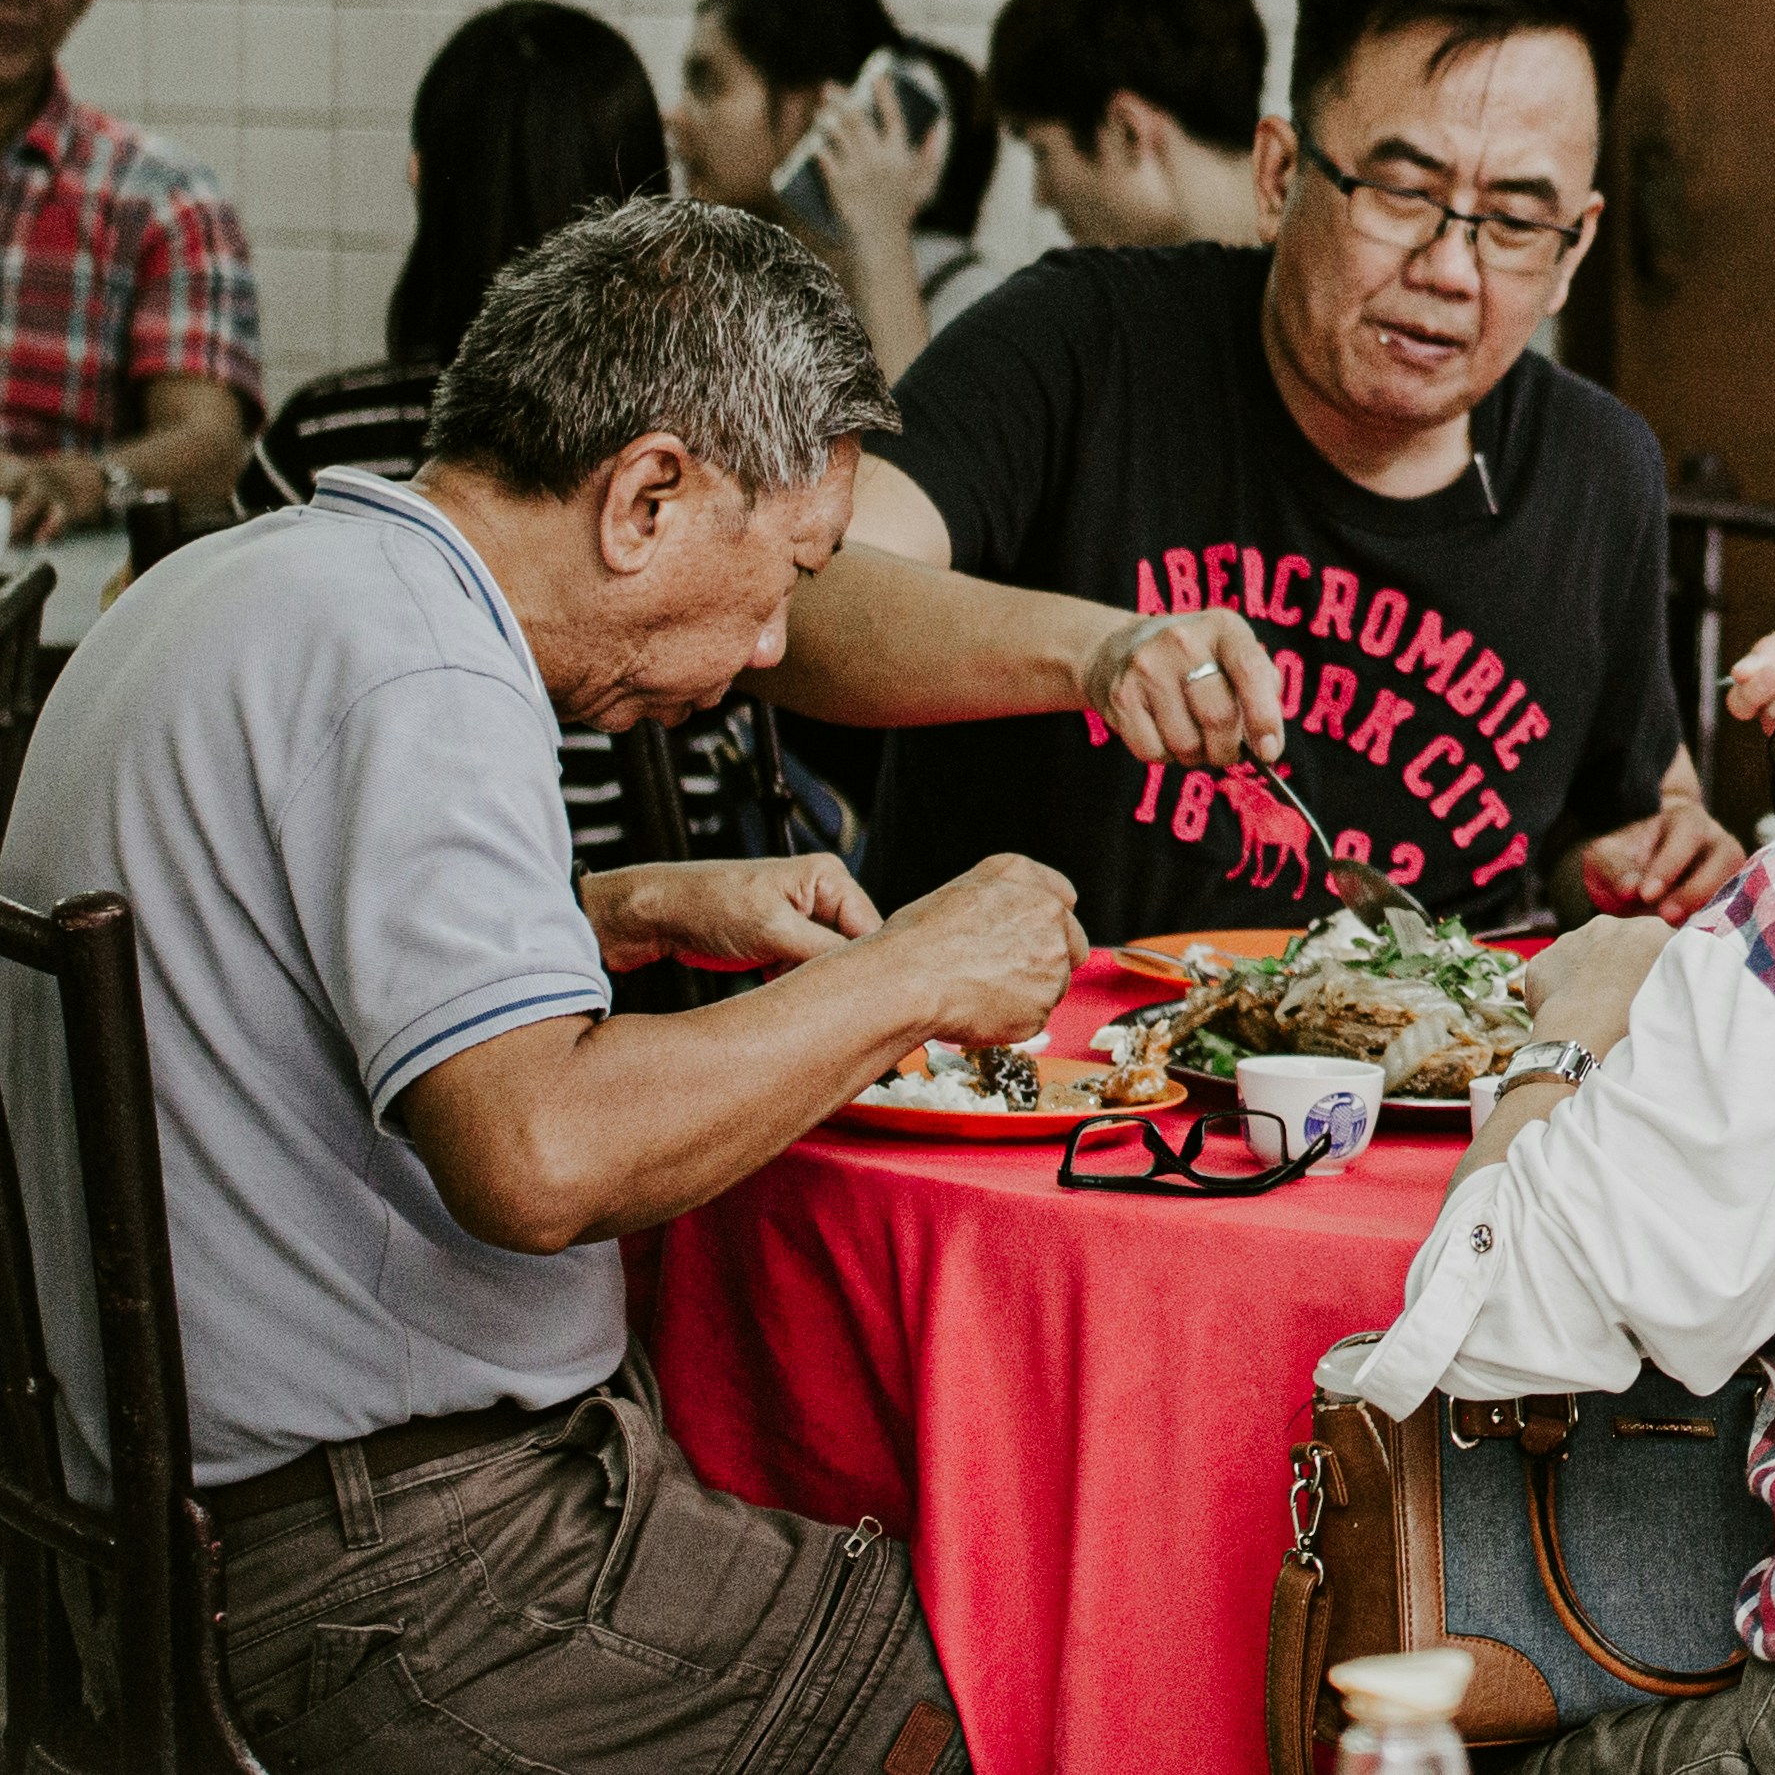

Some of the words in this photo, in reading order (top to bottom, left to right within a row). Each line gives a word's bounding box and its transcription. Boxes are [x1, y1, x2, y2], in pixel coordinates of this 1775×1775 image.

[1134, 763, 1215, 843] 18
[1263, 644, 1415, 766] ORK
[1402, 734, 1530, 888] CITY
